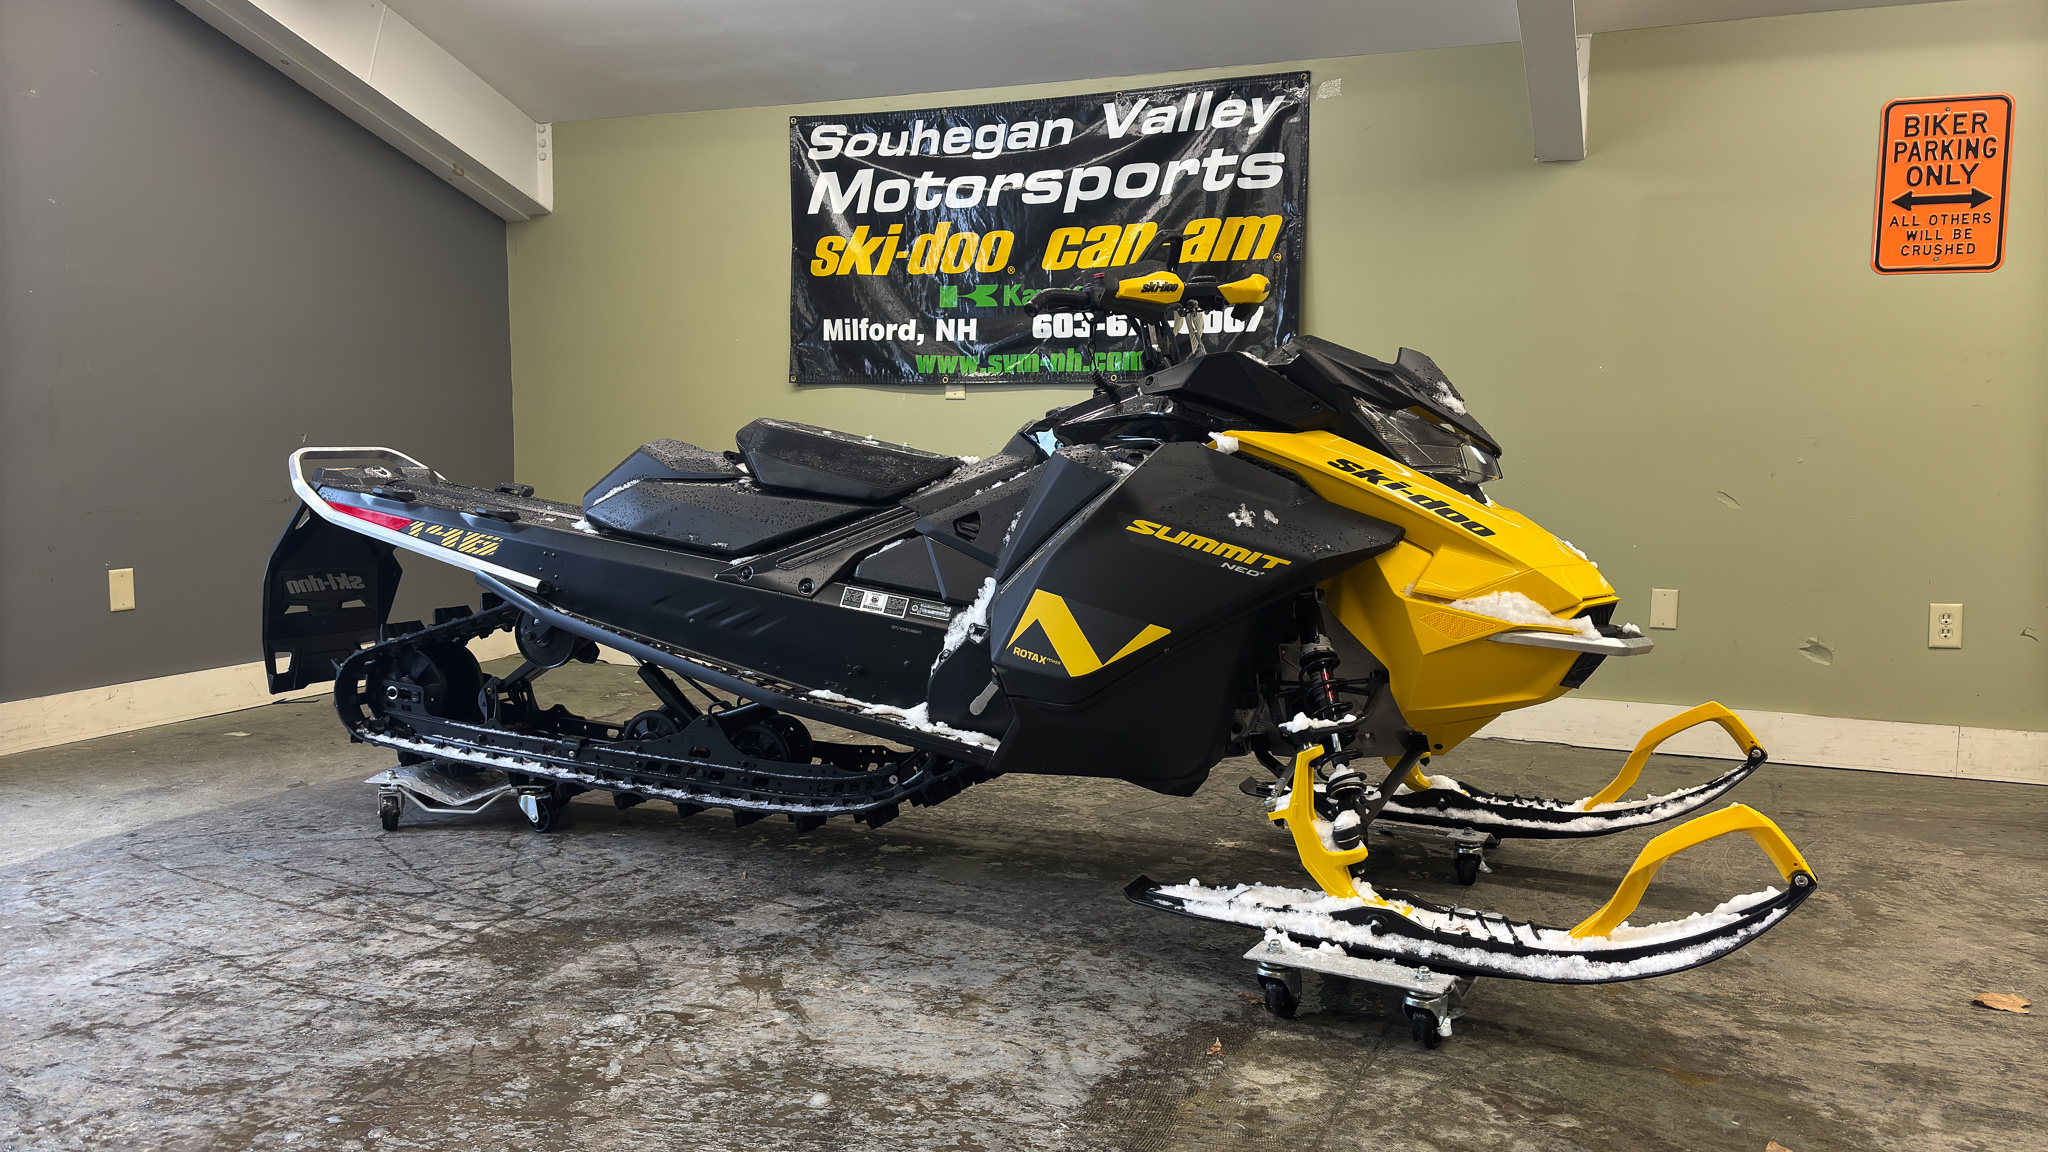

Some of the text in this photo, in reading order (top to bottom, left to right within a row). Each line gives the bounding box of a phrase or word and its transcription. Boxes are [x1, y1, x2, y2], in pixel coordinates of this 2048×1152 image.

[807, 91, 1286, 161] Souhegan Valley
[1904, 112, 1988, 138] BIKER
[1893, 136, 1998, 163] PARKING
[807, 148, 1286, 215] Motorsports
[1906, 162, 1981, 187] ONLY
[1889, 213, 1992, 228] ALL OTHERS
[1906, 228, 1973, 241] WILL BE
[1900, 243, 1976, 257] CRUSHED
[823, 318, 925, 345] Milford,
[935, 318, 978, 342] NH
[915, 348, 1144, 374] www.svm-nh.com
[1327, 458, 1496, 537] ski-doo
[1125, 519, 1292, 569] SUMMIT
[1012, 646, 1047, 665] ROTAX
